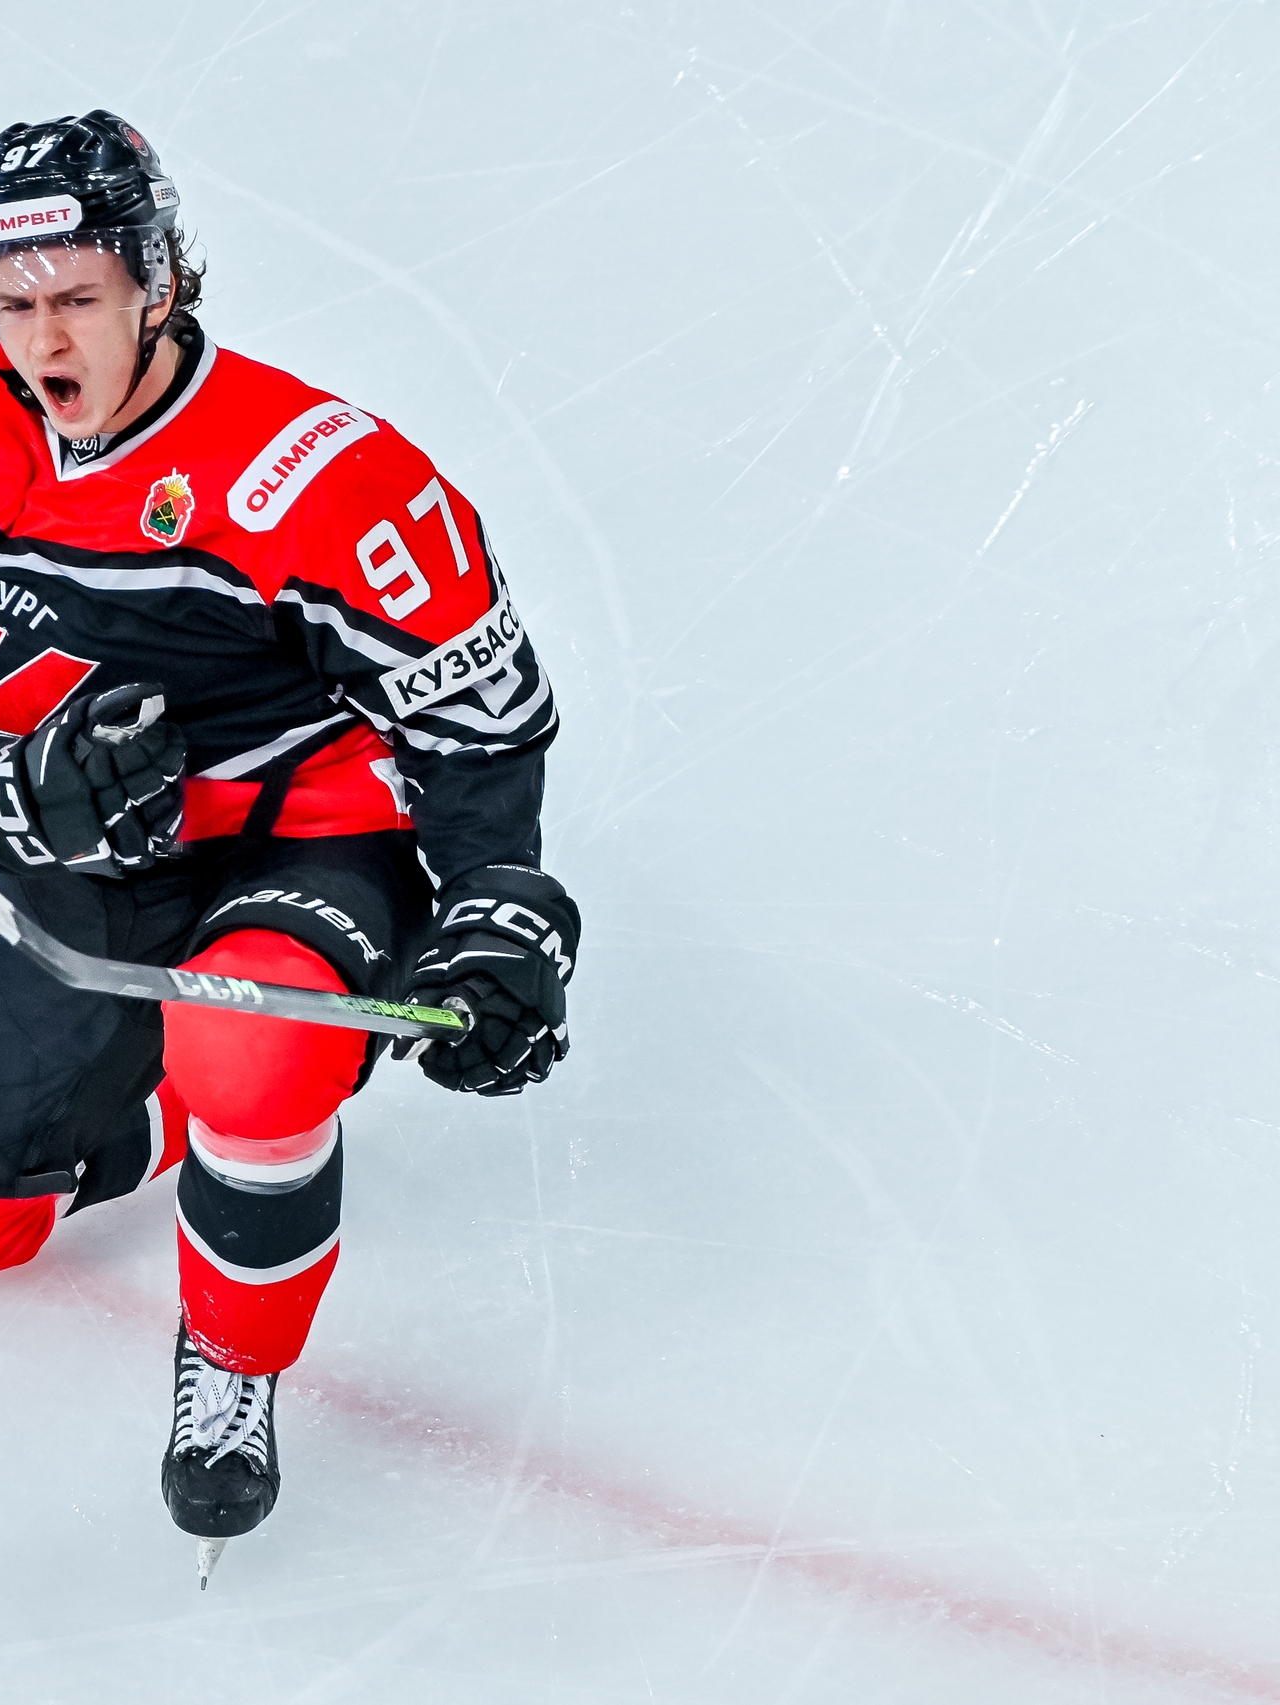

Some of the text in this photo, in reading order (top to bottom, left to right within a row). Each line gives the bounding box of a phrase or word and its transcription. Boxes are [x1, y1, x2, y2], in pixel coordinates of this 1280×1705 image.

[0, 143, 53, 173] 97
[246, 411, 358, 512] OLIMPBET
[356, 476, 469, 621] 97
[394, 600, 519, 705] КУЗБАСС
[441, 899, 572, 980] CCM
[166, 968, 264, 1005] CCM
